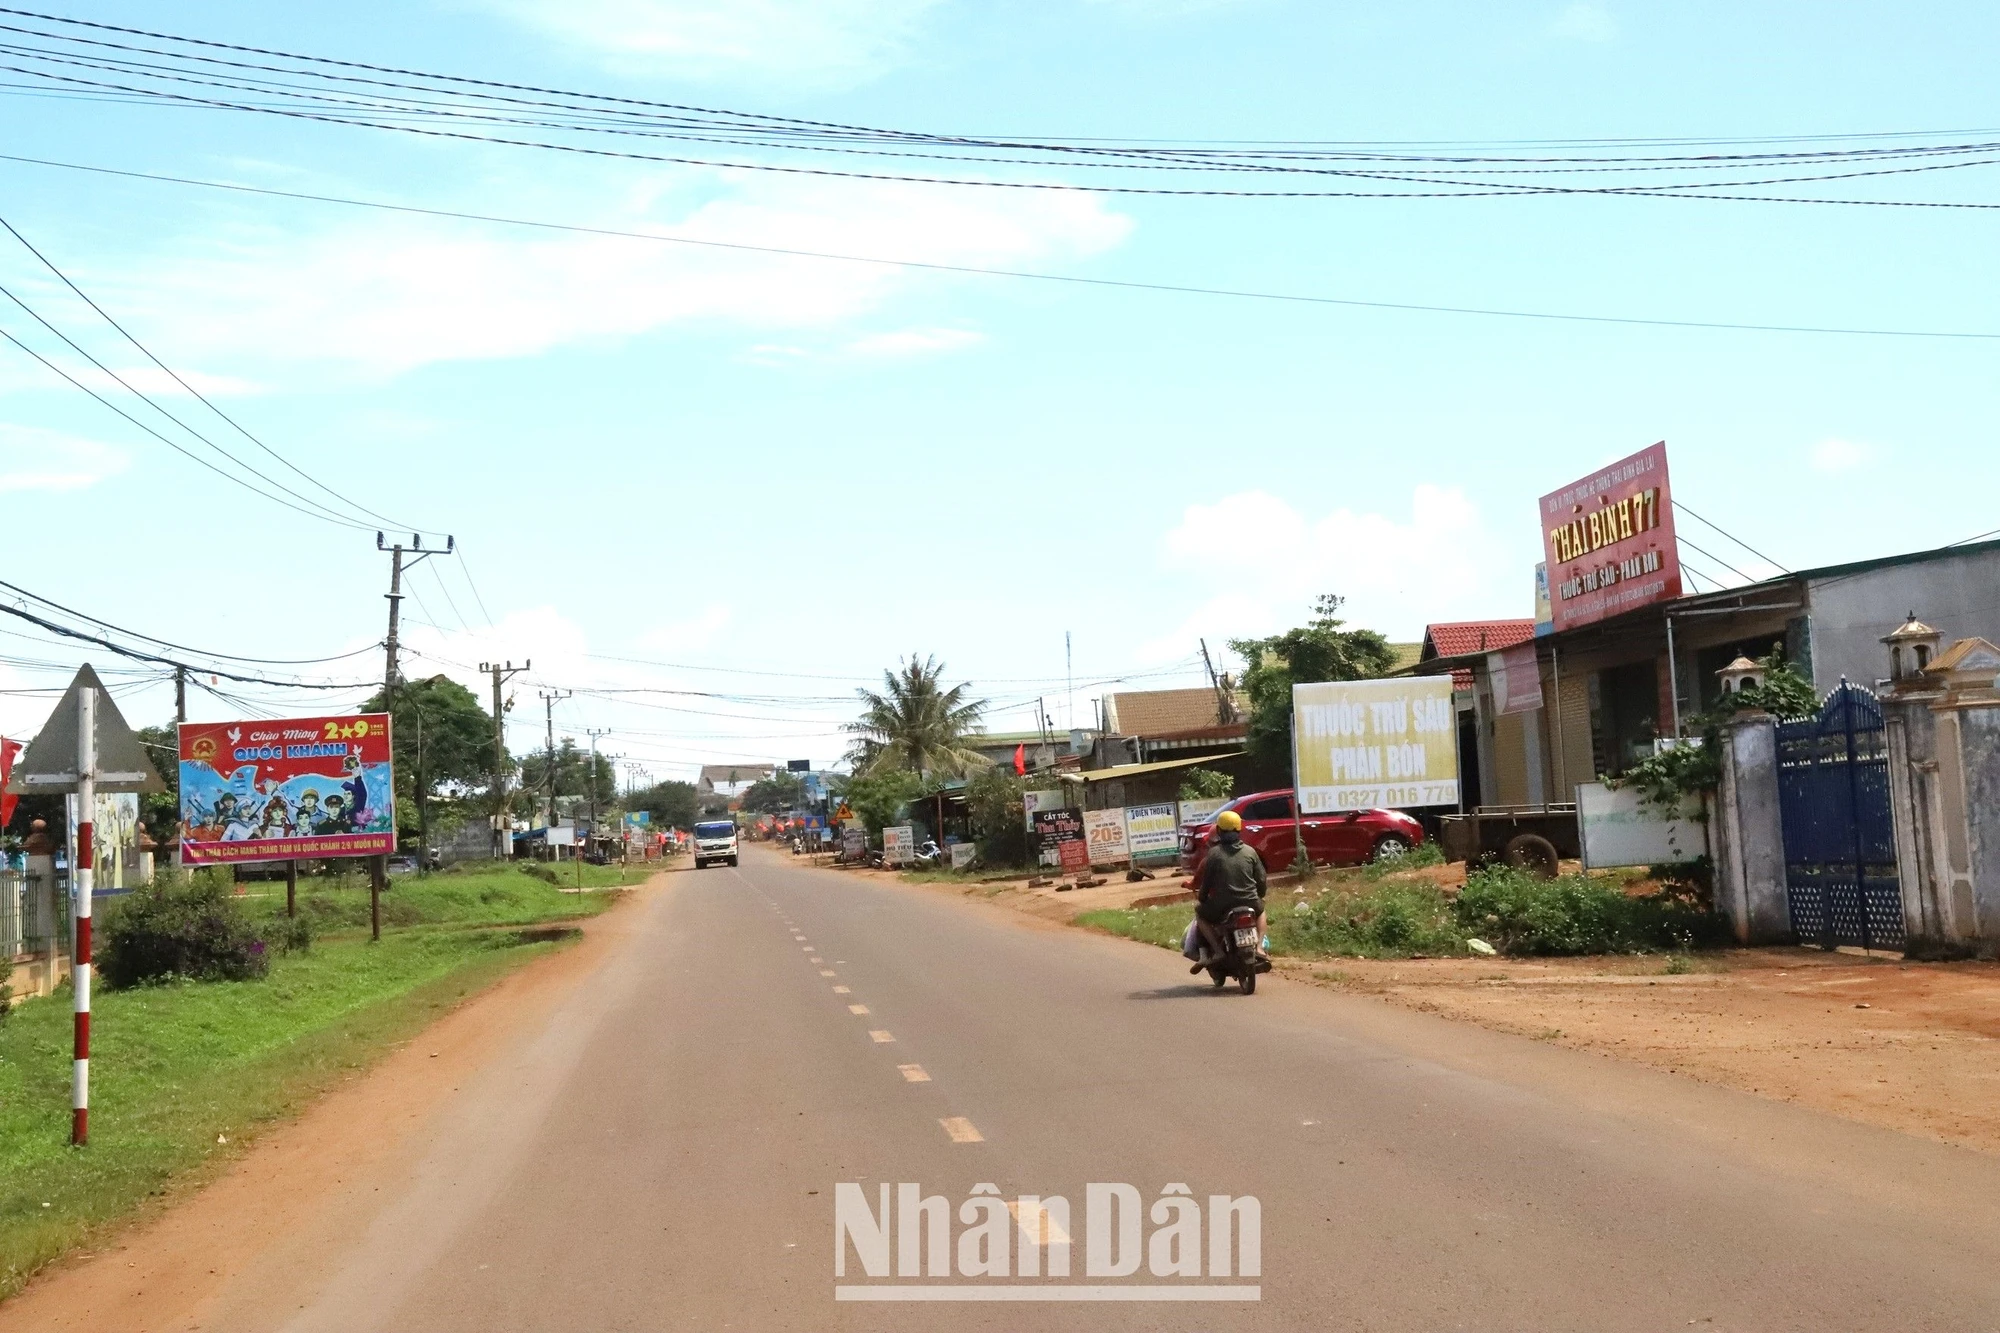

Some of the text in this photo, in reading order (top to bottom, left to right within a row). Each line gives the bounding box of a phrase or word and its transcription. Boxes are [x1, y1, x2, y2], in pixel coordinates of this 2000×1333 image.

[1633, 487, 1656, 533] 77
[1301, 693, 1451, 737] THUỐC TRỪ SÂU
[250, 729, 279, 742] Chào
[283, 729, 319, 742] Mừng
[233, 741, 348, 762] QUỐC KHÁNH
[1331, 739, 1427, 781] PHÂN BÓN
[1338, 789, 1380, 807] 0327
[1386, 787, 1418, 804] 016
[1423, 785, 1455, 802] 779
[1135, 806, 1166, 818] ĐIỆN THOẠI
[222, 845, 239, 857] CÁCH
[258, 844, 279, 855] THÁNG
[302, 840, 319, 852] QUỐC
[320, 840, 340, 851] KHÁNH
[353, 838, 372, 849] MUÔN
